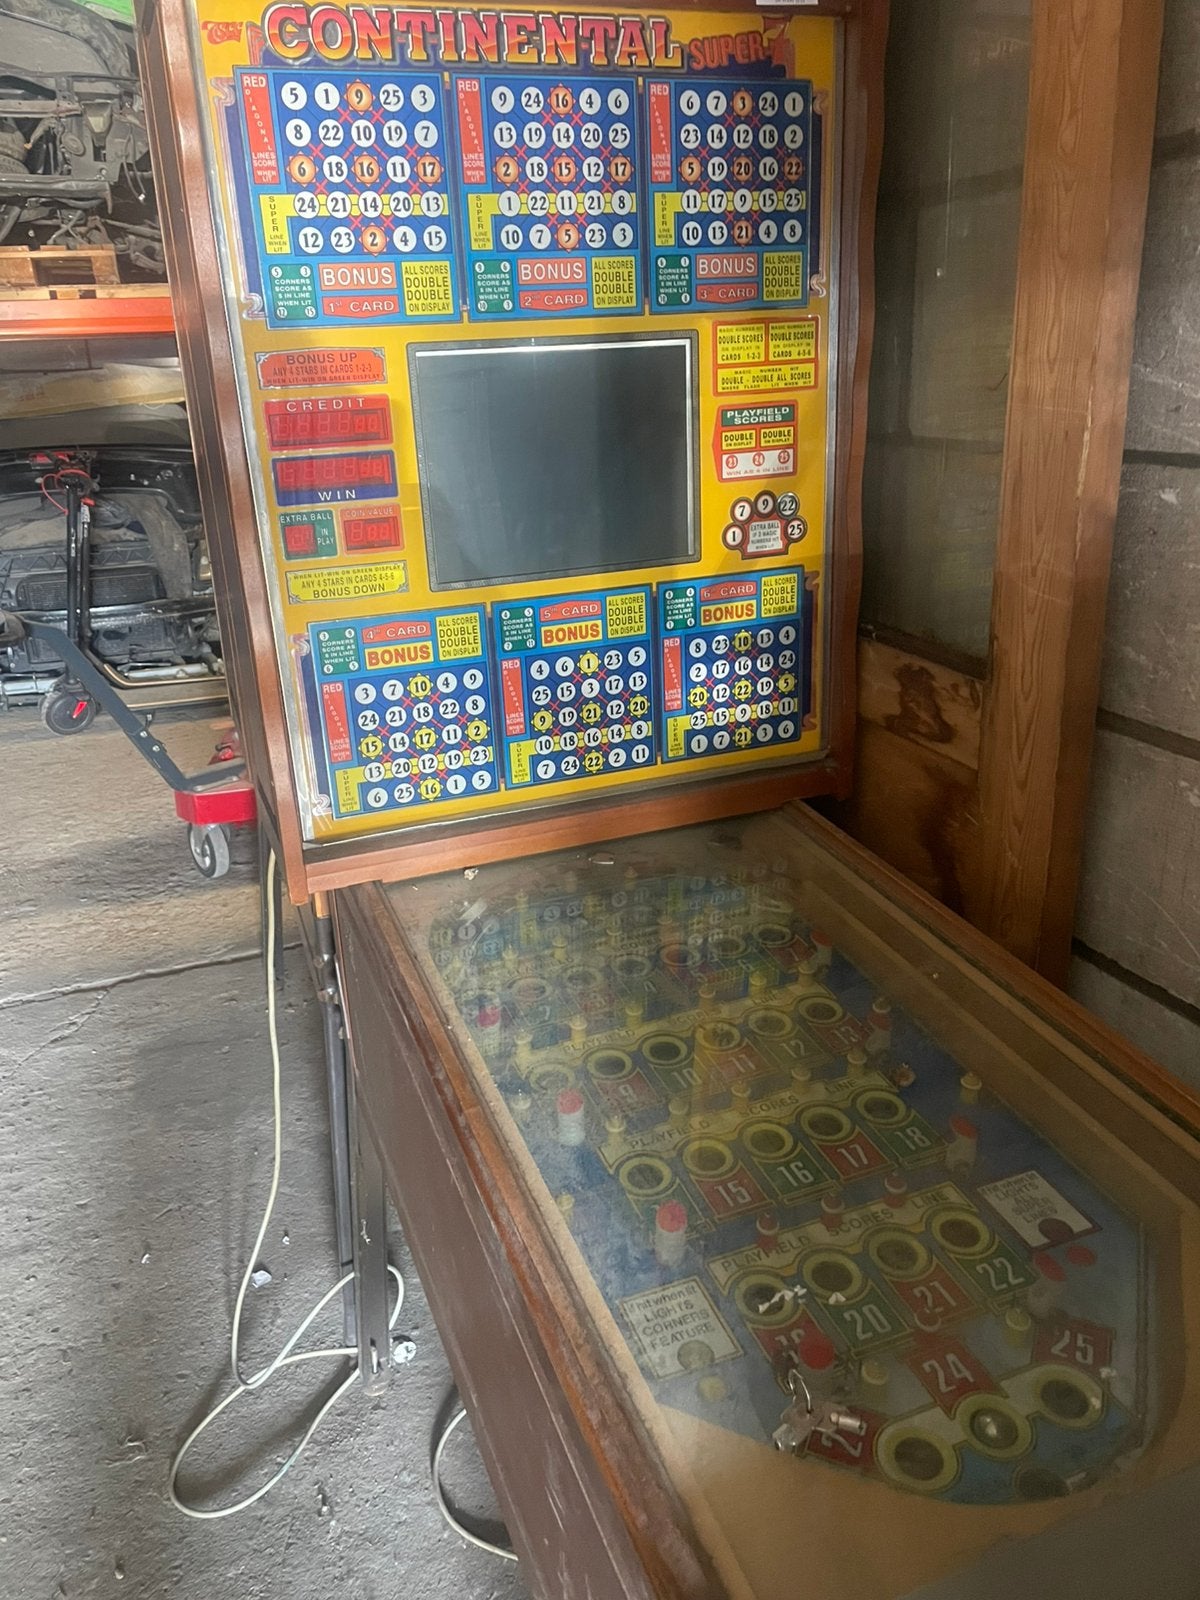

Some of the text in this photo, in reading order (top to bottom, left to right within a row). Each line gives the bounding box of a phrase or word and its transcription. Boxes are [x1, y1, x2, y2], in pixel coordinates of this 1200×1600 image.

[265, 4, 682, 67] CONTINENTAL
[689, 31, 766, 70] SUPER
[244, 76, 266, 87] RED
[458, 80, 479, 92] RED
[651, 84, 669, 95] RED
[321, 124, 341, 141] 22
[355, 125, 372, 141] 10
[387, 125, 403, 141] 19
[498, 127, 628, 143] 13 19 14 20 25
[252, 152, 276, 160] LINES
[253, 159, 276, 167] SCORE
[297, 196, 440, 213] 24 21 14 20 13
[686, 195, 697, 209] 11
[711, 194, 724, 208] 17
[763, 193, 775, 207] 15
[786, 193, 800, 207] 25
[268, 196, 279, 232] SUPER
[405, 265, 449, 275] ALL SCORES
[521, 262, 583, 280] BONUS
[594, 260, 633, 270] ALL SCORES
[699, 257, 755, 275] BONUS
[764, 265, 800, 277] DOUBLE
[322, 267, 392, 286] BONUS
[406, 276, 449, 288] DOUBLE
[594, 271, 633, 282] DOUBLE
[594, 283, 634, 294] DOUBLE
[765, 277, 801, 289] DOUBLE
[406, 289, 450, 301] DOUBLE
[718, 288, 755, 299] CARD
[350, 300, 394, 312] CARD
[544, 294, 584, 306] CARD
[409, 302, 449, 312] ON DISPLAY
[719, 333, 764, 344] DOUBLE SCORES
[770, 330, 814, 342] DOUBLE SCORES
[286, 352, 357, 365] BONUS UP
[721, 353, 741, 361] CARDS
[772, 350, 792, 358] CARDS
[272, 367, 287, 377] ANY
[295, 365, 318, 375] STARS
[320, 365, 327, 374] IN
[329, 364, 354, 373] CARDS
[286, 397, 365, 412] CREDIT
[726, 406, 789, 418] PLAYFIELD
[734, 414, 782, 425] SCORES
[724, 432, 754, 442] DOUBLE
[762, 429, 792, 439] DOUBLE
[318, 489, 356, 501] WIN
[366, 506, 393, 515] VALUE
[782, 499, 794, 511] 22
[280, 512, 332, 523] EXTRA BALL
[321, 528, 328, 536] IN
[750, 521, 779, 531] EXTRA BALL
[789, 524, 802, 536] 25
[317, 537, 334, 546] PLAY
[301, 580, 315, 589] ANY
[323, 577, 345, 587] STARS
[346, 576, 353, 584] IN
[354, 574, 377, 584] CARDS
[379, 572, 394, 581] 4-5-6
[313, 583, 385, 599] BONUS DOWN
[720, 584, 754, 596] CARD
[762, 585, 795, 596] DOUBLE
[608, 595, 644, 606] ALL SCORES
[762, 594, 795, 606] DOUBLE
[561, 604, 598, 616] CARD
[608, 605, 644, 617] DOUBLE
[702, 603, 754, 623] BONUS
[438, 616, 478, 627] ALL SCORES
[609, 615, 644, 627] DOUBLE
[386, 625, 426, 637] CARD
[439, 625, 478, 638] DOUBLE
[543, 623, 600, 644] BONUS
[440, 635, 479, 649] DOUBLE
[367, 644, 431, 667] BONUS
[442, 647, 479, 657] ON DISPLAY
[360, 713, 377, 727] 24
[389, 710, 403, 723] 21
[416, 706, 430, 719] 18
[442, 702, 457, 715] 22
[692, 714, 706, 726] 25
[716, 711, 727, 723] 15
[760, 704, 771, 715] 18
[782, 700, 791, 712] 11
[539, 739, 551, 751] 10
[563, 735, 576, 747] 18
[587, 731, 599, 744] 16
[610, 727, 623, 740] 14
[368, 749, 488, 779] 13 20 12 19 23
[833, 1026, 860, 1044] 13
[825, 1079, 858, 1094] LINE
[895, 1127, 931, 1150] 18
[837, 1144, 868, 1168] 17
[777, 1161, 814, 1187] 16
[714, 1181, 751, 1207] 15
[829, 1209, 894, 1236] SCORES
[911, 1190, 949, 1209] LINE
[976, 1257, 1025, 1291] 22
[914, 1281, 956, 1307] 21
[643, 1300, 694, 1323] LIGHTS
[642, 1311, 711, 1337] CORNERS
[843, 1304, 892, 1340] 20
[649, 1322, 712, 1350] FEATURE
[1050, 1329, 1094, 1365] 25
[922, 1352, 974, 1393] 24
